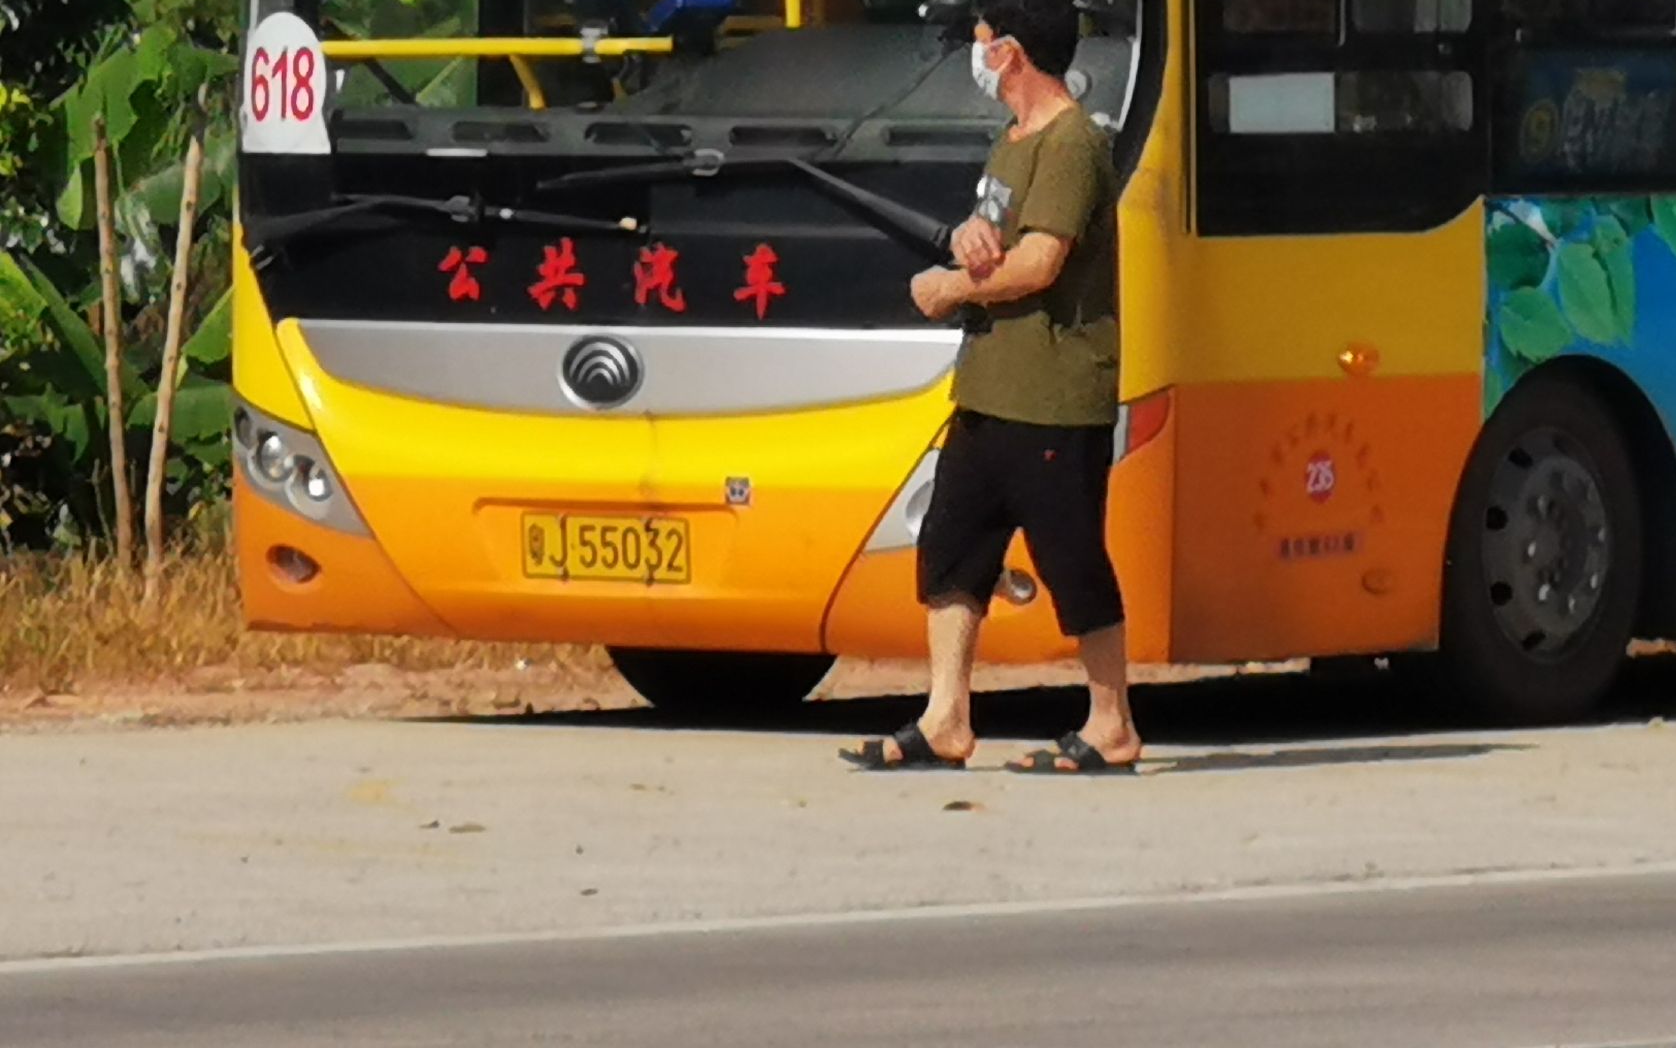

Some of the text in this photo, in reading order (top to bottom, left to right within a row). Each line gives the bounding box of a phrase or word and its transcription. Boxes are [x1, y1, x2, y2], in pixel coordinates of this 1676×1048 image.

[250, 46, 315, 122] 618
[437, 237, 787, 321] 公共汽车
